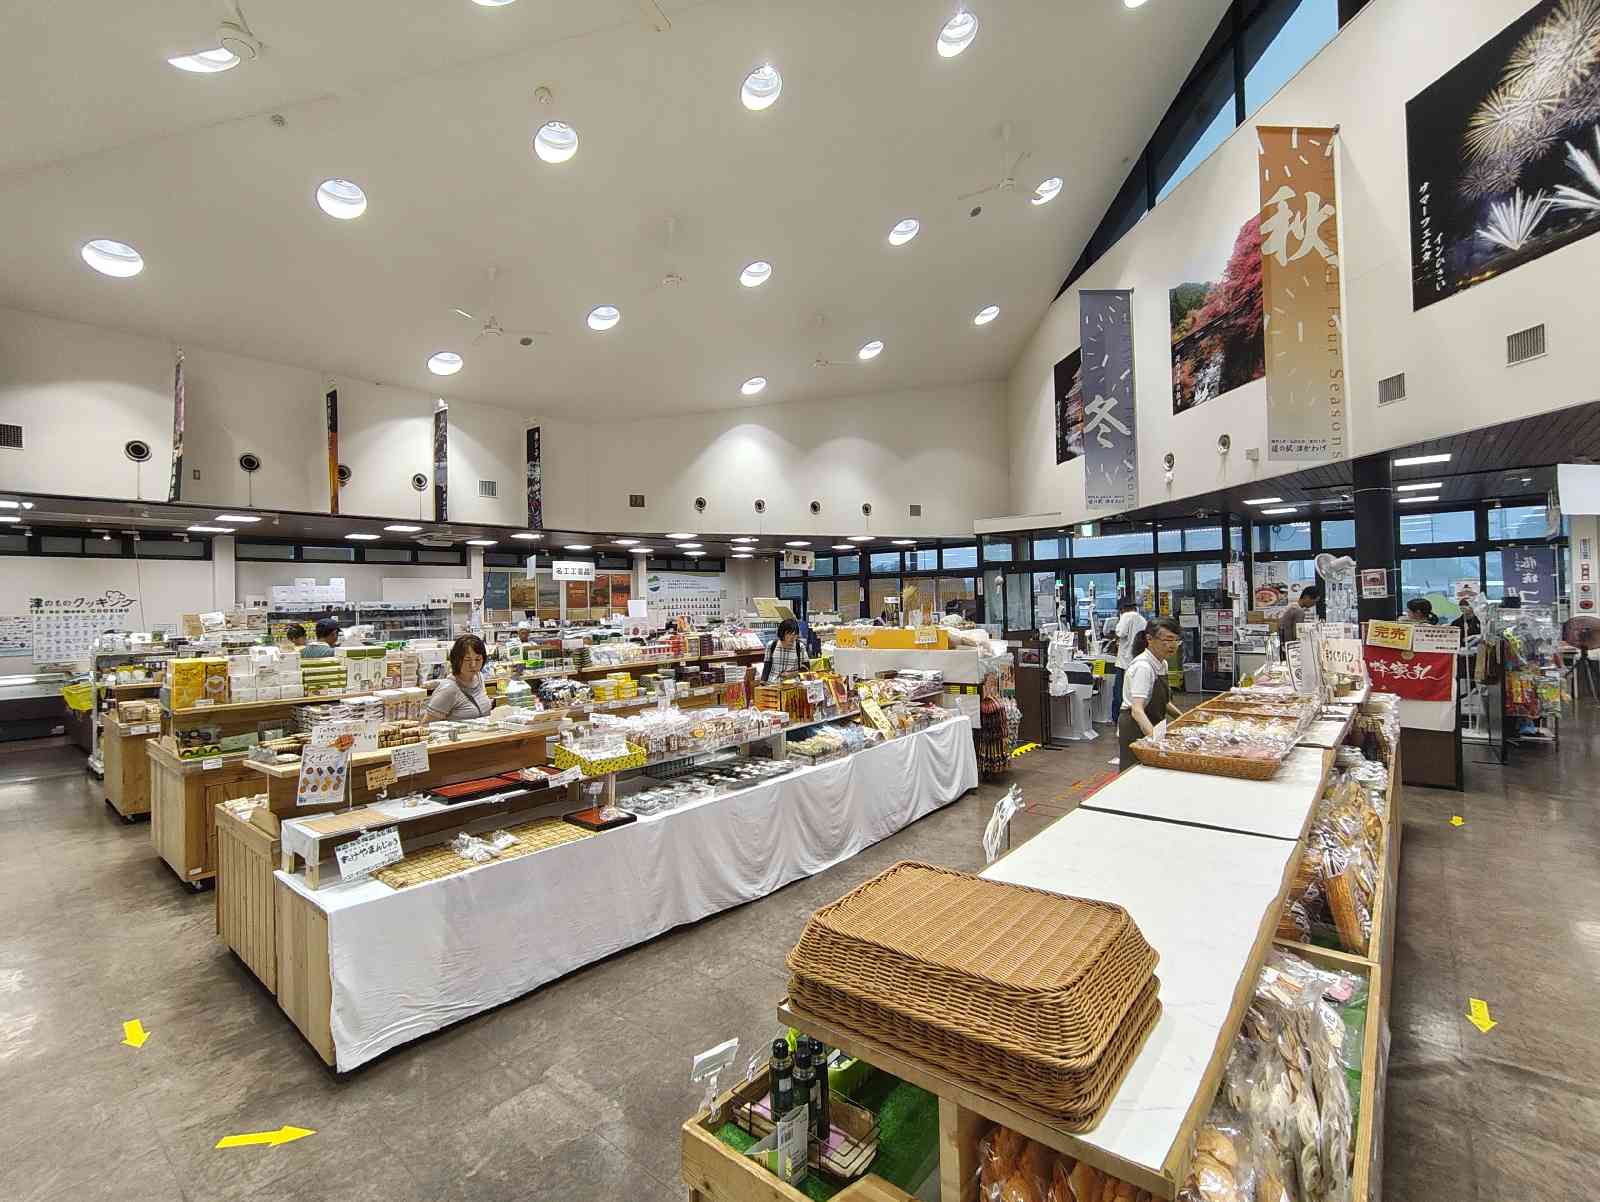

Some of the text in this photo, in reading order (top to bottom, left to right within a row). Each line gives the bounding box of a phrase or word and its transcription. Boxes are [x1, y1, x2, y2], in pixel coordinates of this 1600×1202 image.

[1260, 185, 1338, 267] 秋
[1419, 182, 1432, 263] サマーフェスタ
[1084, 394, 1131, 449] 冬
[1329, 368, 1346, 459] Seasons
[29, 598, 137, 608] 津のものクッキング
[1374, 626, 1407, 641] 完売
